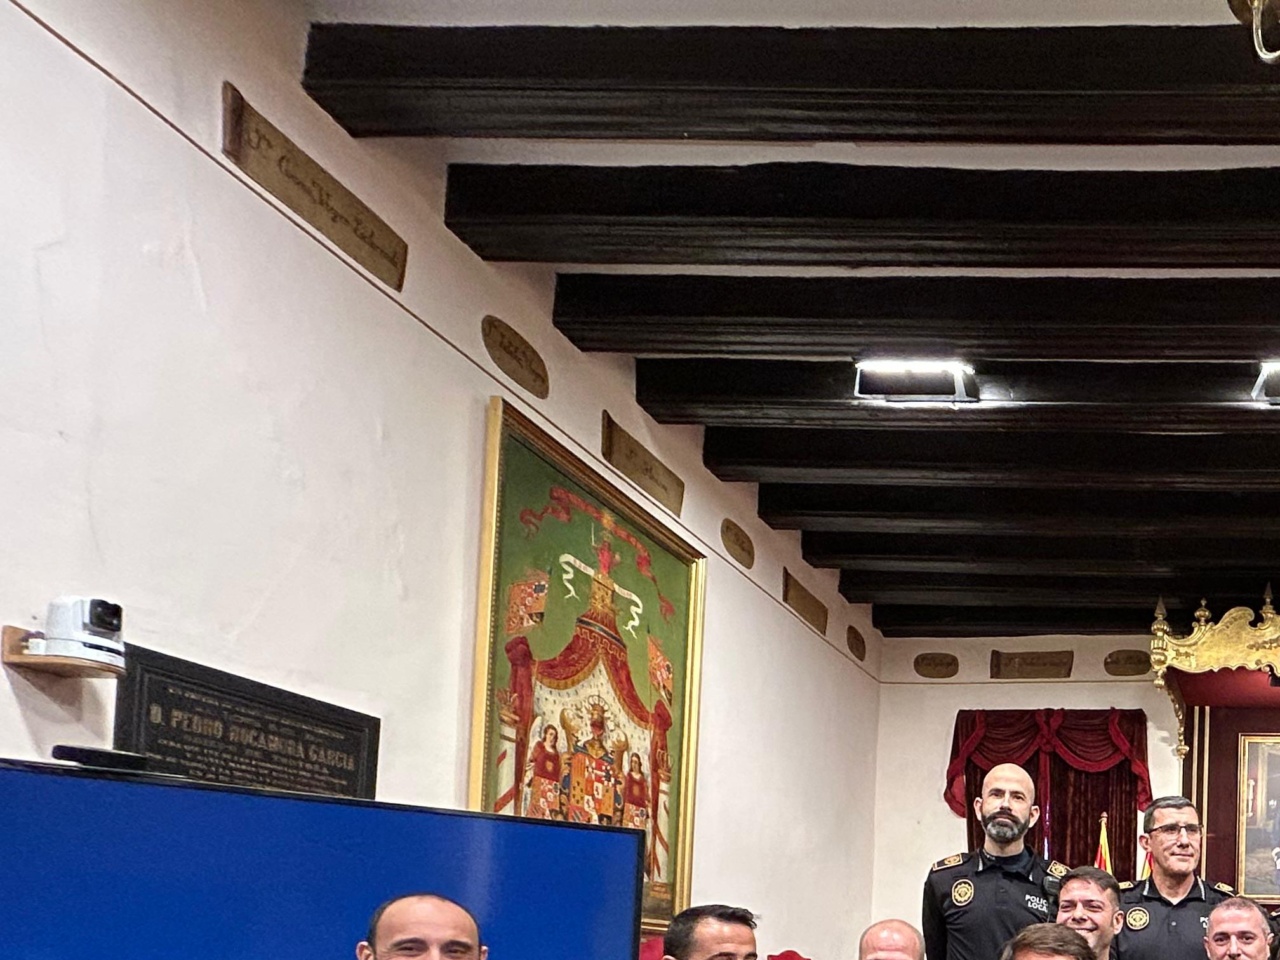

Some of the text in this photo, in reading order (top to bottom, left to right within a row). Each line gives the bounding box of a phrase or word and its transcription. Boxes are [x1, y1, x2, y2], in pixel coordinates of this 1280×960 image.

[170, 708, 224, 739] PEDRO
[309, 744, 355, 771] GARCIA
[1025, 894, 1049, 907] POLIC
[1027, 901, 1049, 913] LOCA
